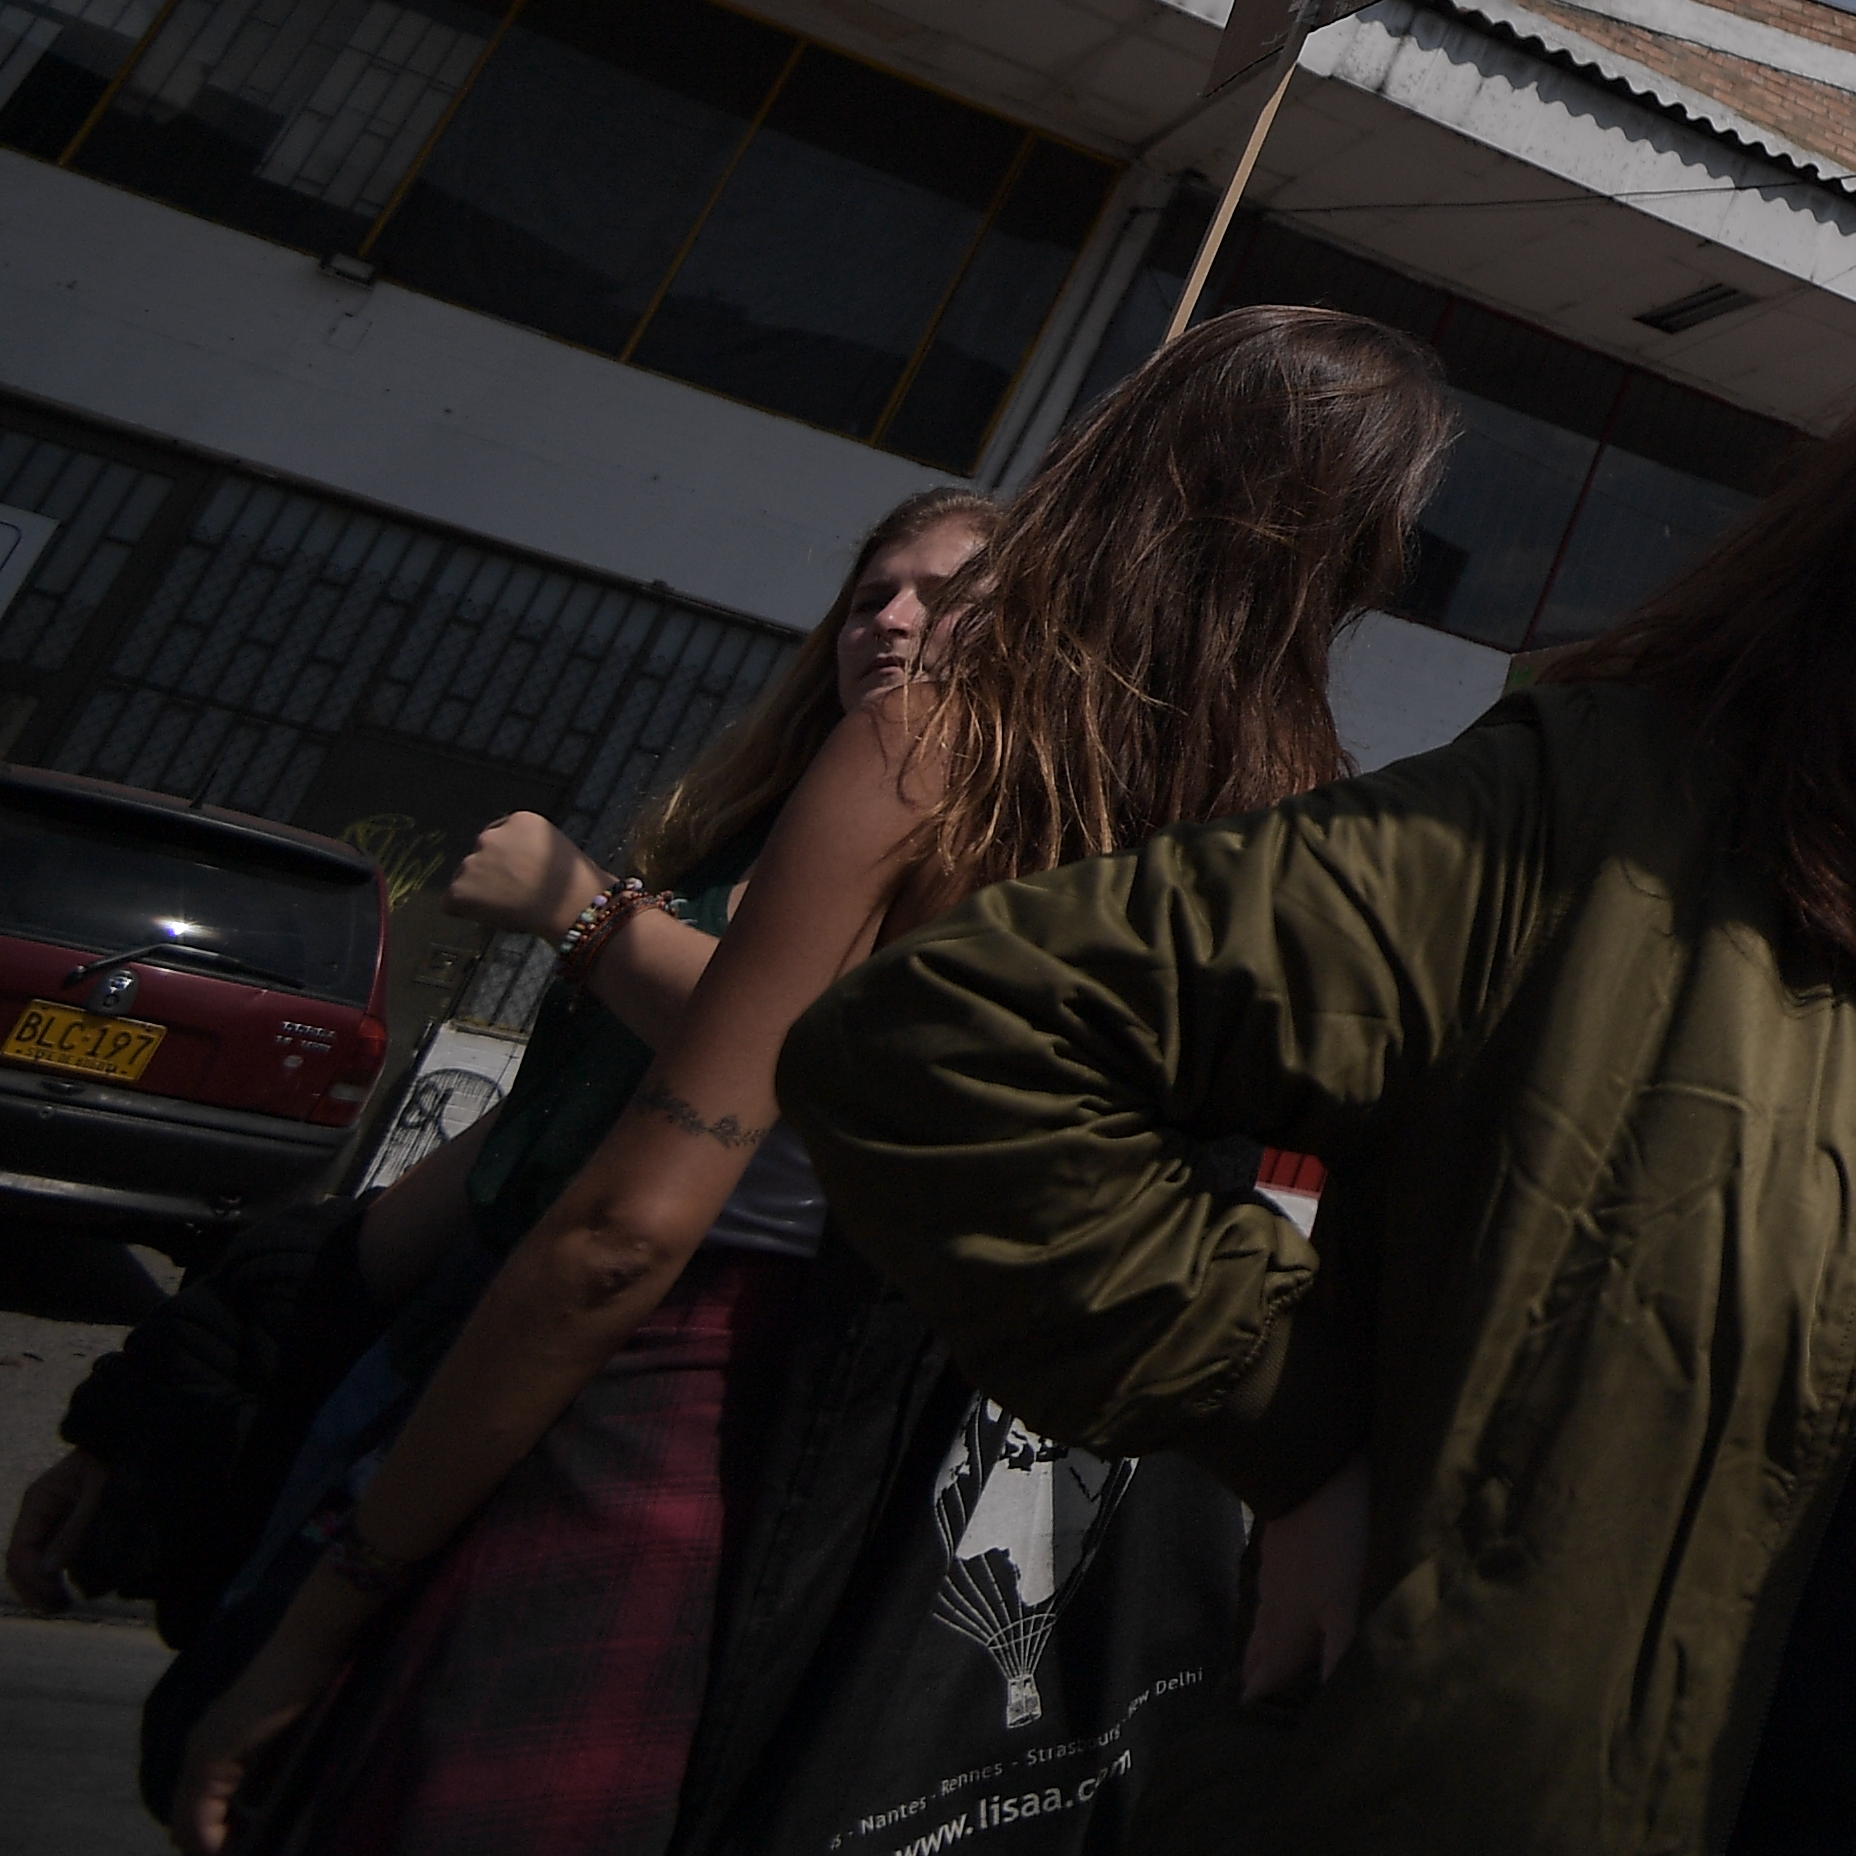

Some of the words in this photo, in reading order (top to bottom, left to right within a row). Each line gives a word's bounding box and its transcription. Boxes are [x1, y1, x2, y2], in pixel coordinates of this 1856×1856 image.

[859, 1796, 928, 1835] Nantes
[940, 1761, 1005, 1796] Rennes
[1155, 1666, 1204, 1695] Delhi
